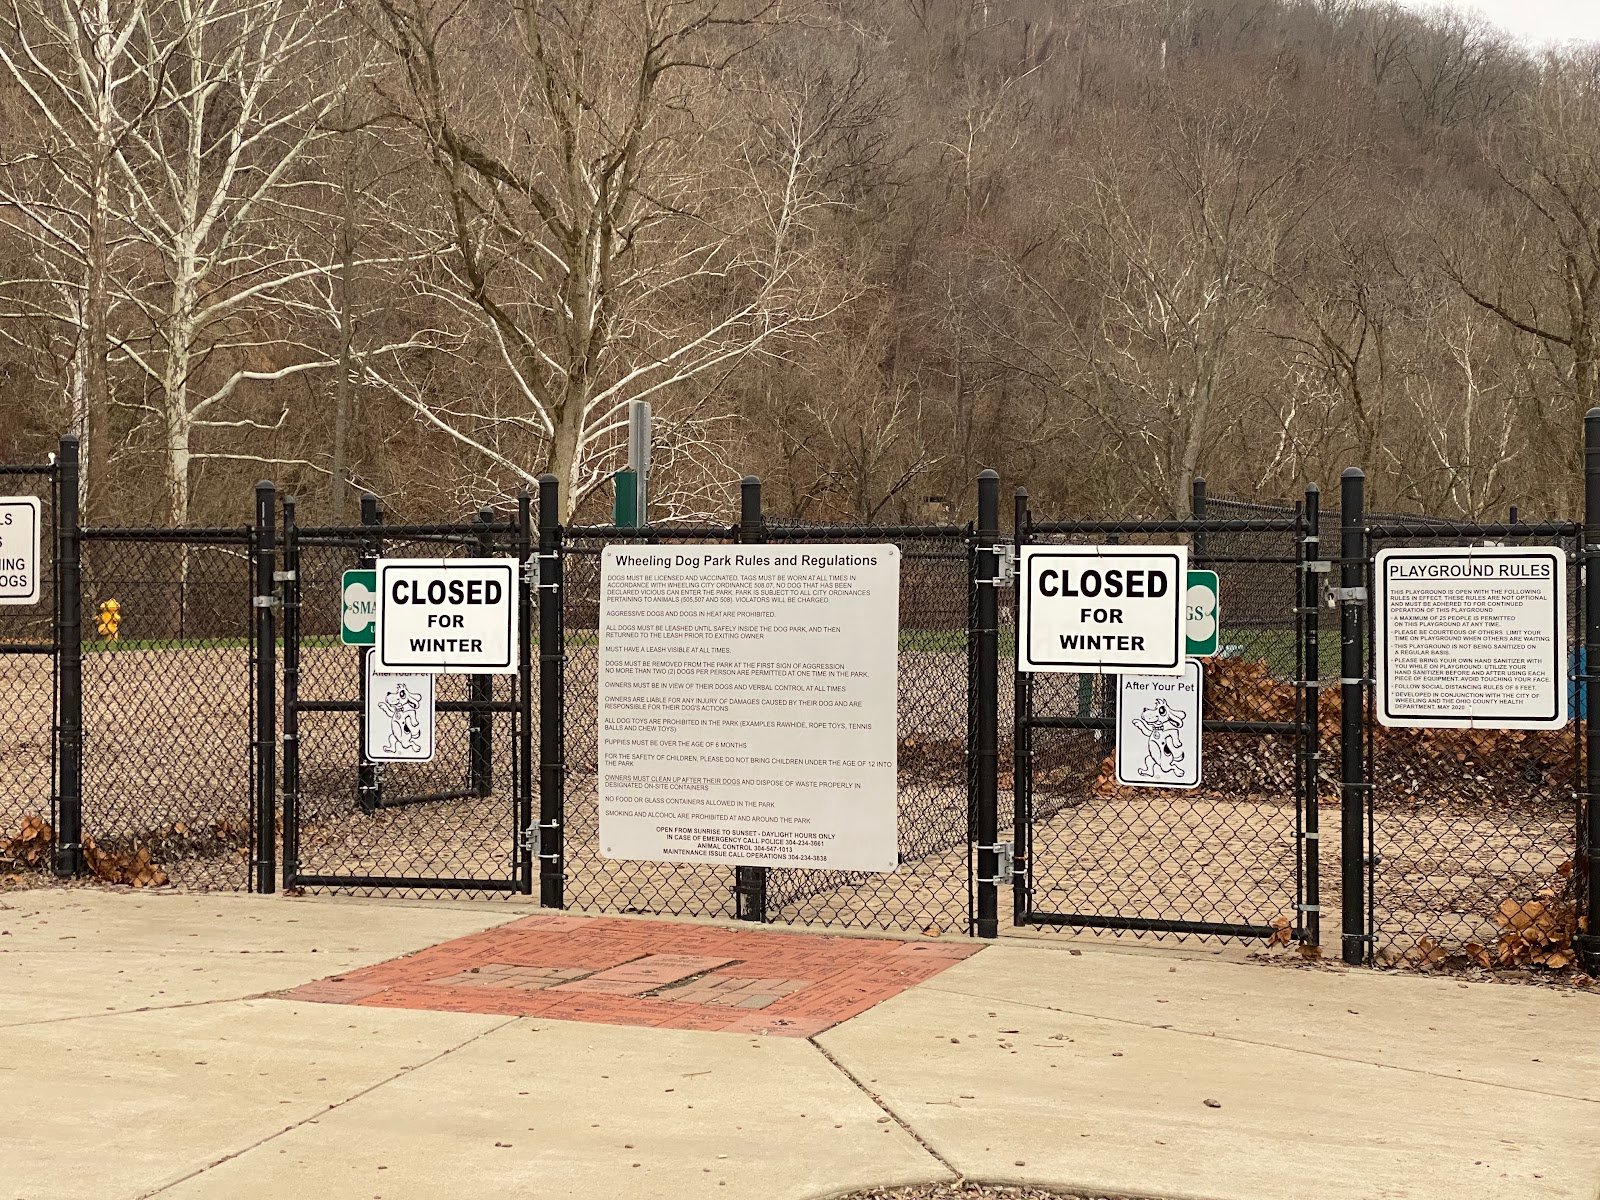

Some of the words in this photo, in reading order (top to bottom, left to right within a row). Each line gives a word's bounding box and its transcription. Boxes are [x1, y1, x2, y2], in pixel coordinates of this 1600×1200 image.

[615, 555, 671, 568] Wheeling
[675, 555, 700, 568] Dog
[704, 554, 731, 567] Park
[735, 554, 770, 566] Rules
[774, 554, 797, 566] and
[801, 554, 878, 569] Regulations
[1390, 564, 1494, 577] PLAYGROUND
[1499, 564, 1550, 577] RULES
[1039, 569, 1168, 598] CLOSED
[392, 580, 502, 605] CLOSED
[428, 614, 464, 628] FOR
[1080, 608, 1123, 623] FOR
[410, 639, 483, 652] WINTER
[1060, 635, 1145, 651] WINTER
[1125, 681, 1149, 690] After
[1152, 682, 1176, 691] Your
[1178, 683, 1195, 692] Pet
[690, 813, 728, 821] PROHIBITED
[663, 848, 707, 856] MAINTENANCE
